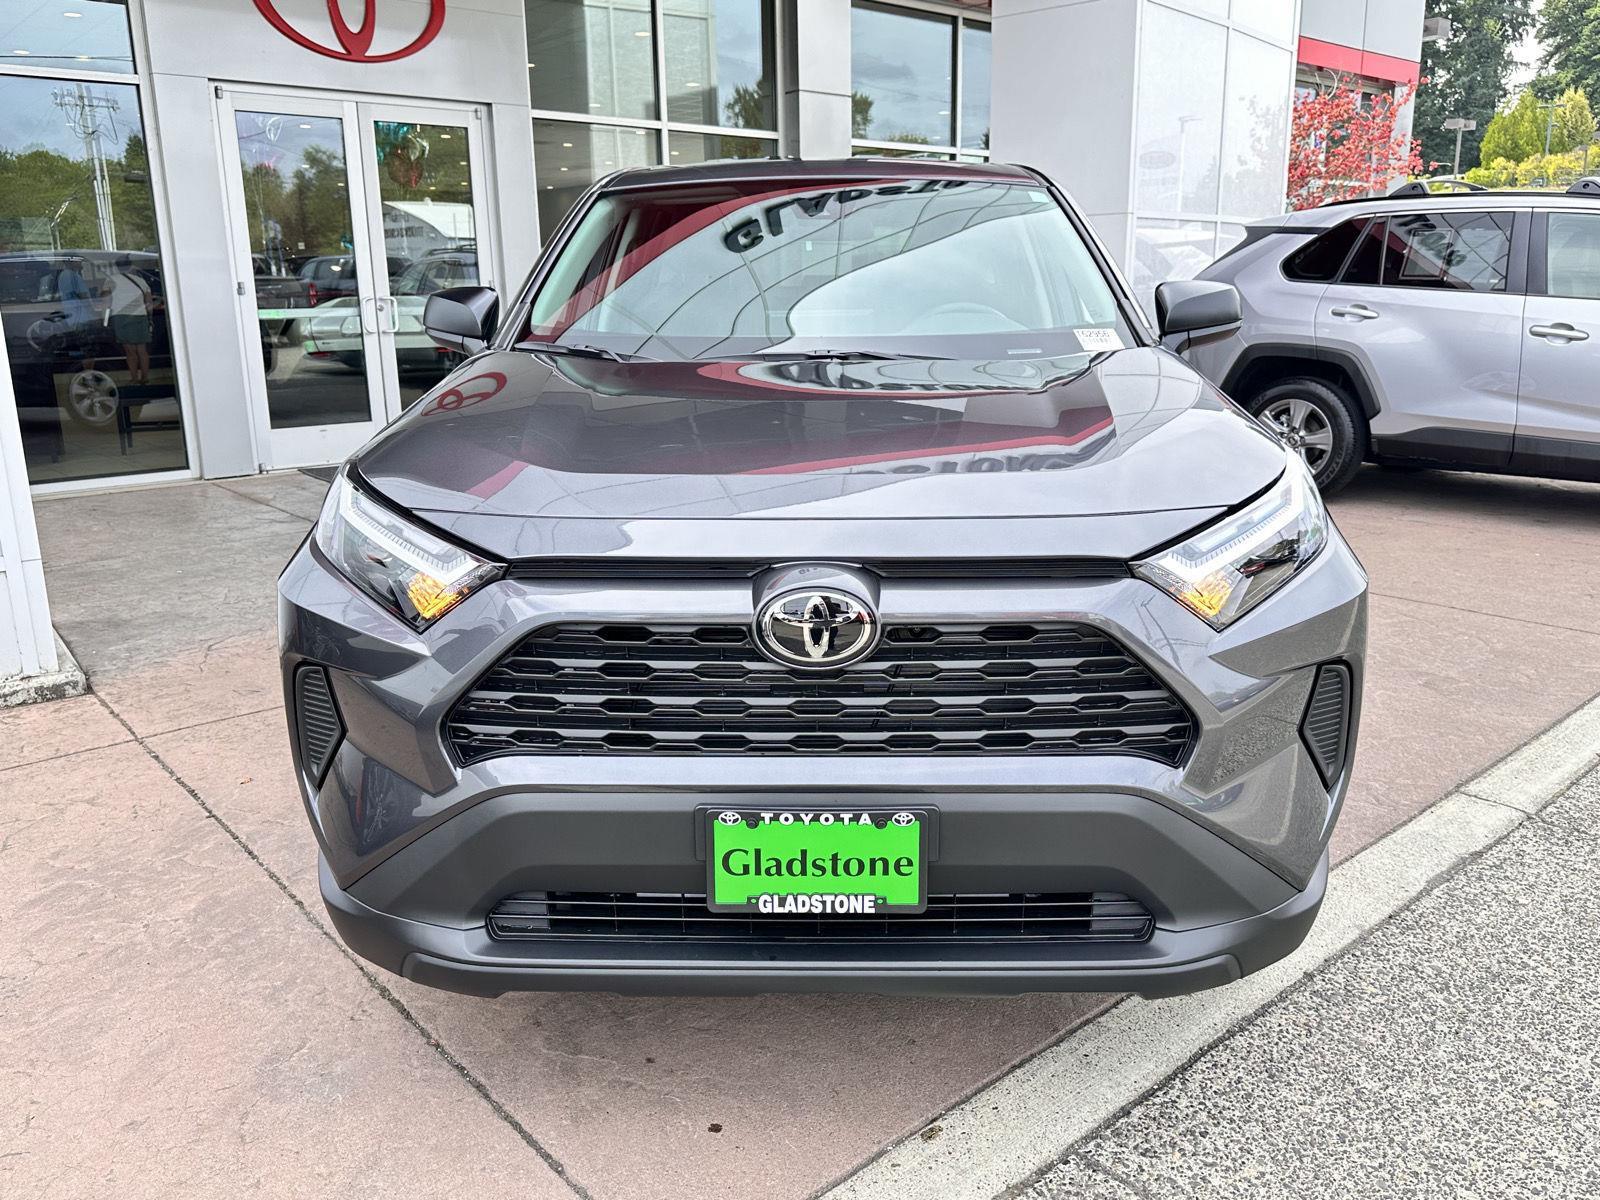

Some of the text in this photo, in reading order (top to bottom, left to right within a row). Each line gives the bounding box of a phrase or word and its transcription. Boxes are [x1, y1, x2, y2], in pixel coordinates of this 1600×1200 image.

[760, 812, 874, 826] TOYOTA
[721, 848, 915, 877] Gladstone
[758, 894, 876, 914] GLADSTONE
